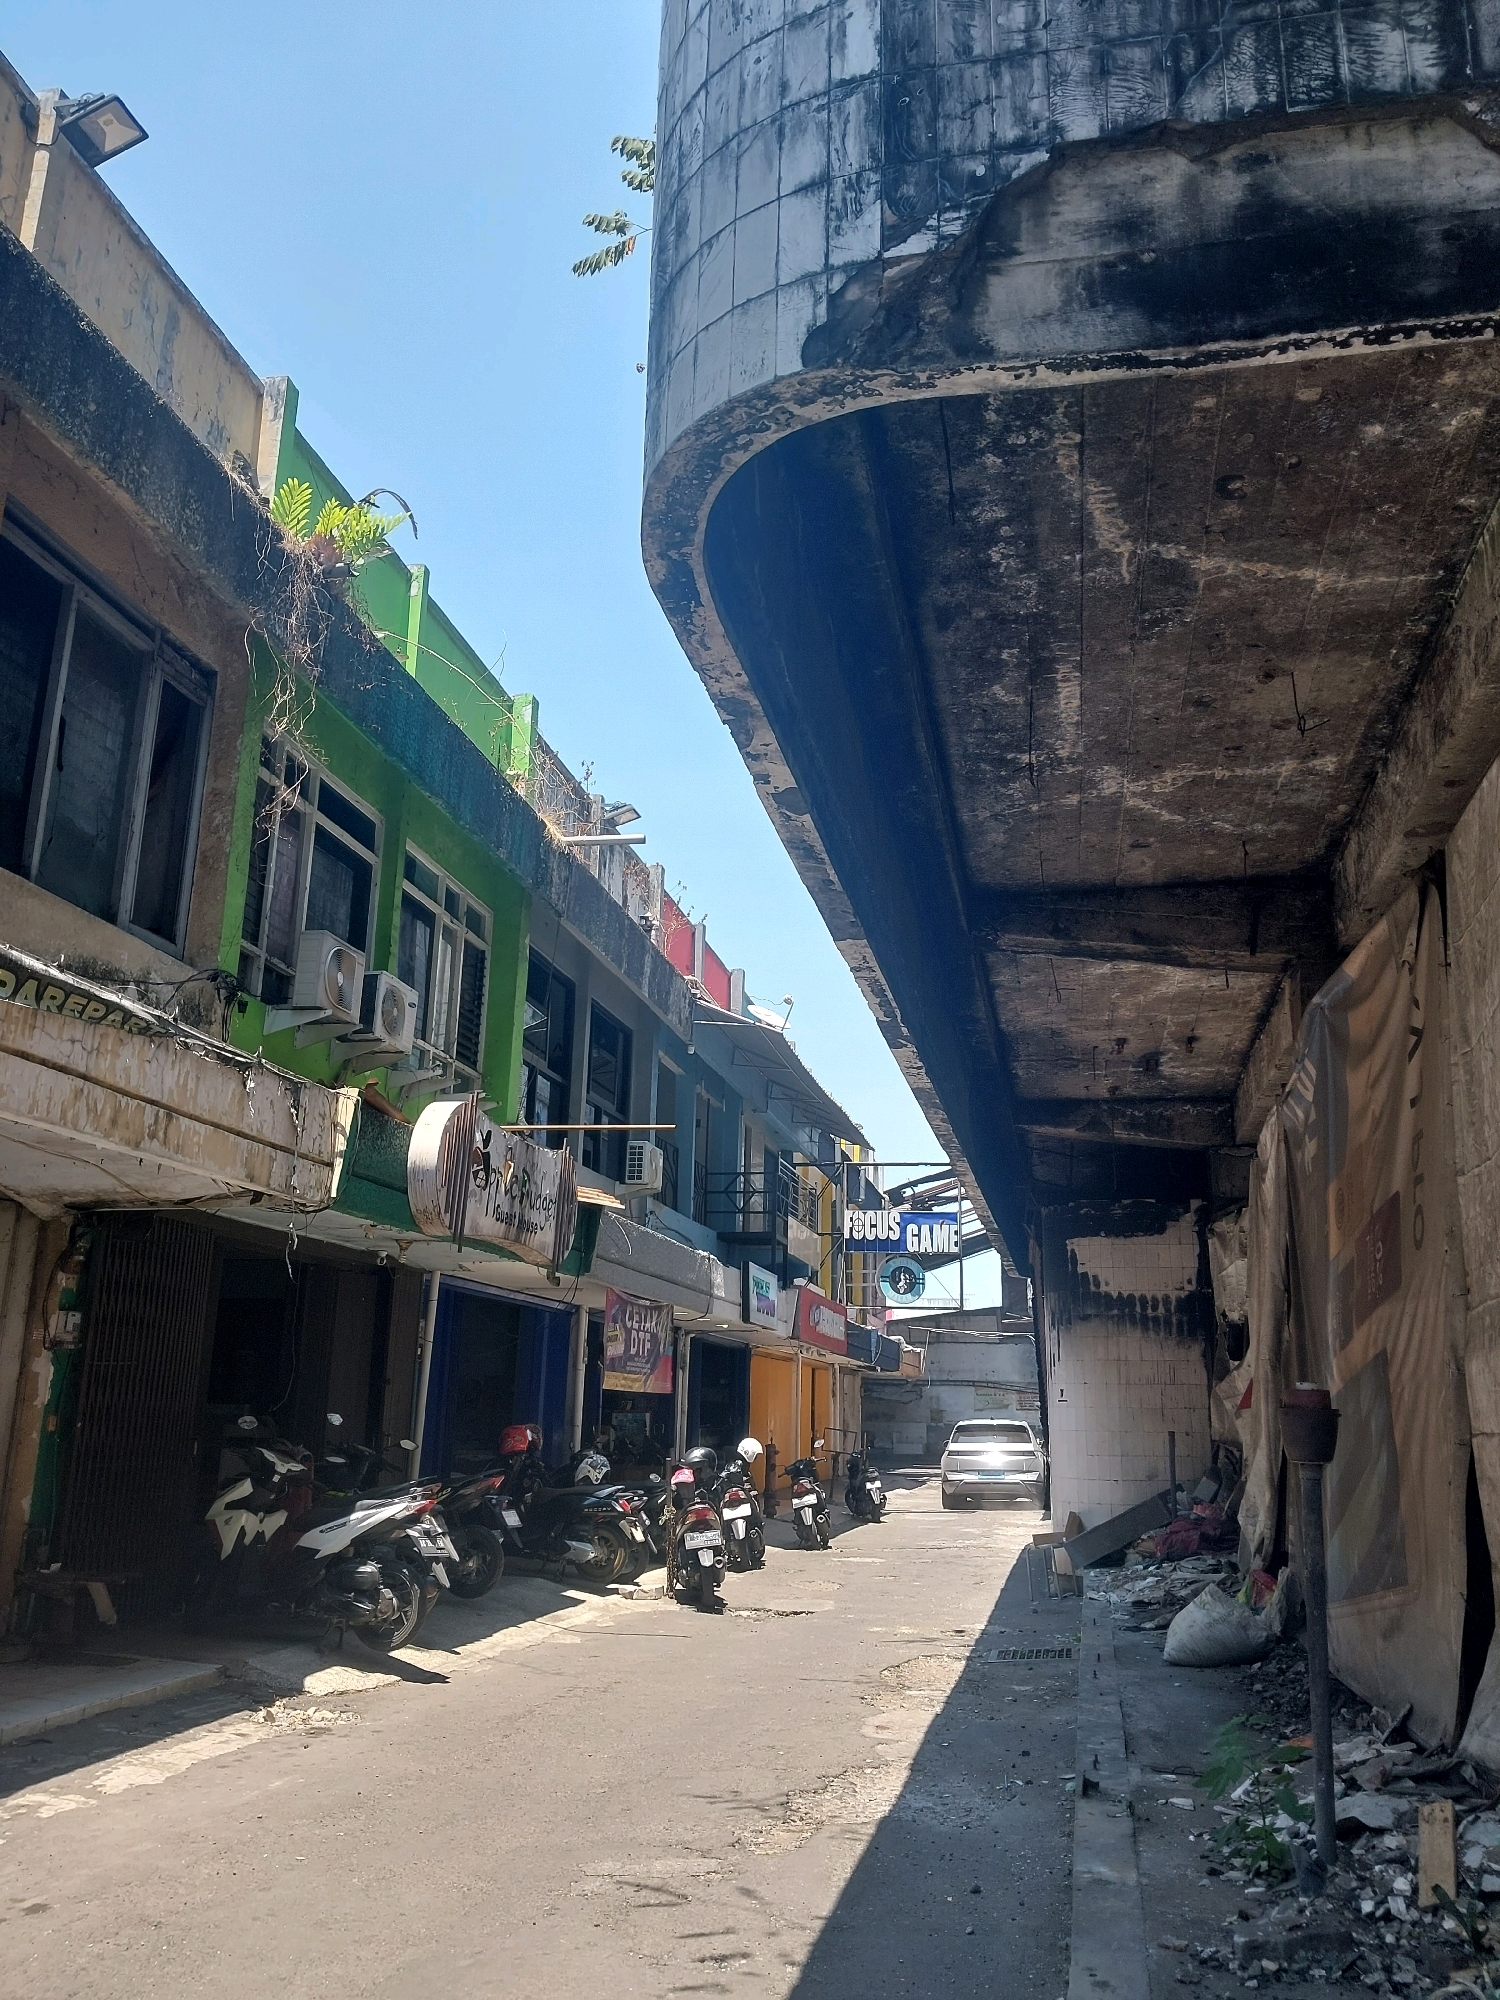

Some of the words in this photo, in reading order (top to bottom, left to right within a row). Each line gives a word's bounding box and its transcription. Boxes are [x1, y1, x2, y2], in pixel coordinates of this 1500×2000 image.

[495, 1204, 517, 1228] Guest
[517, 1213, 538, 1234] House
[844, 1211, 900, 1240] FOCUS
[906, 1223, 959, 1253] GAME
[625, 1303, 658, 1333] CETAK
[630, 1329, 651, 1356] DTF
